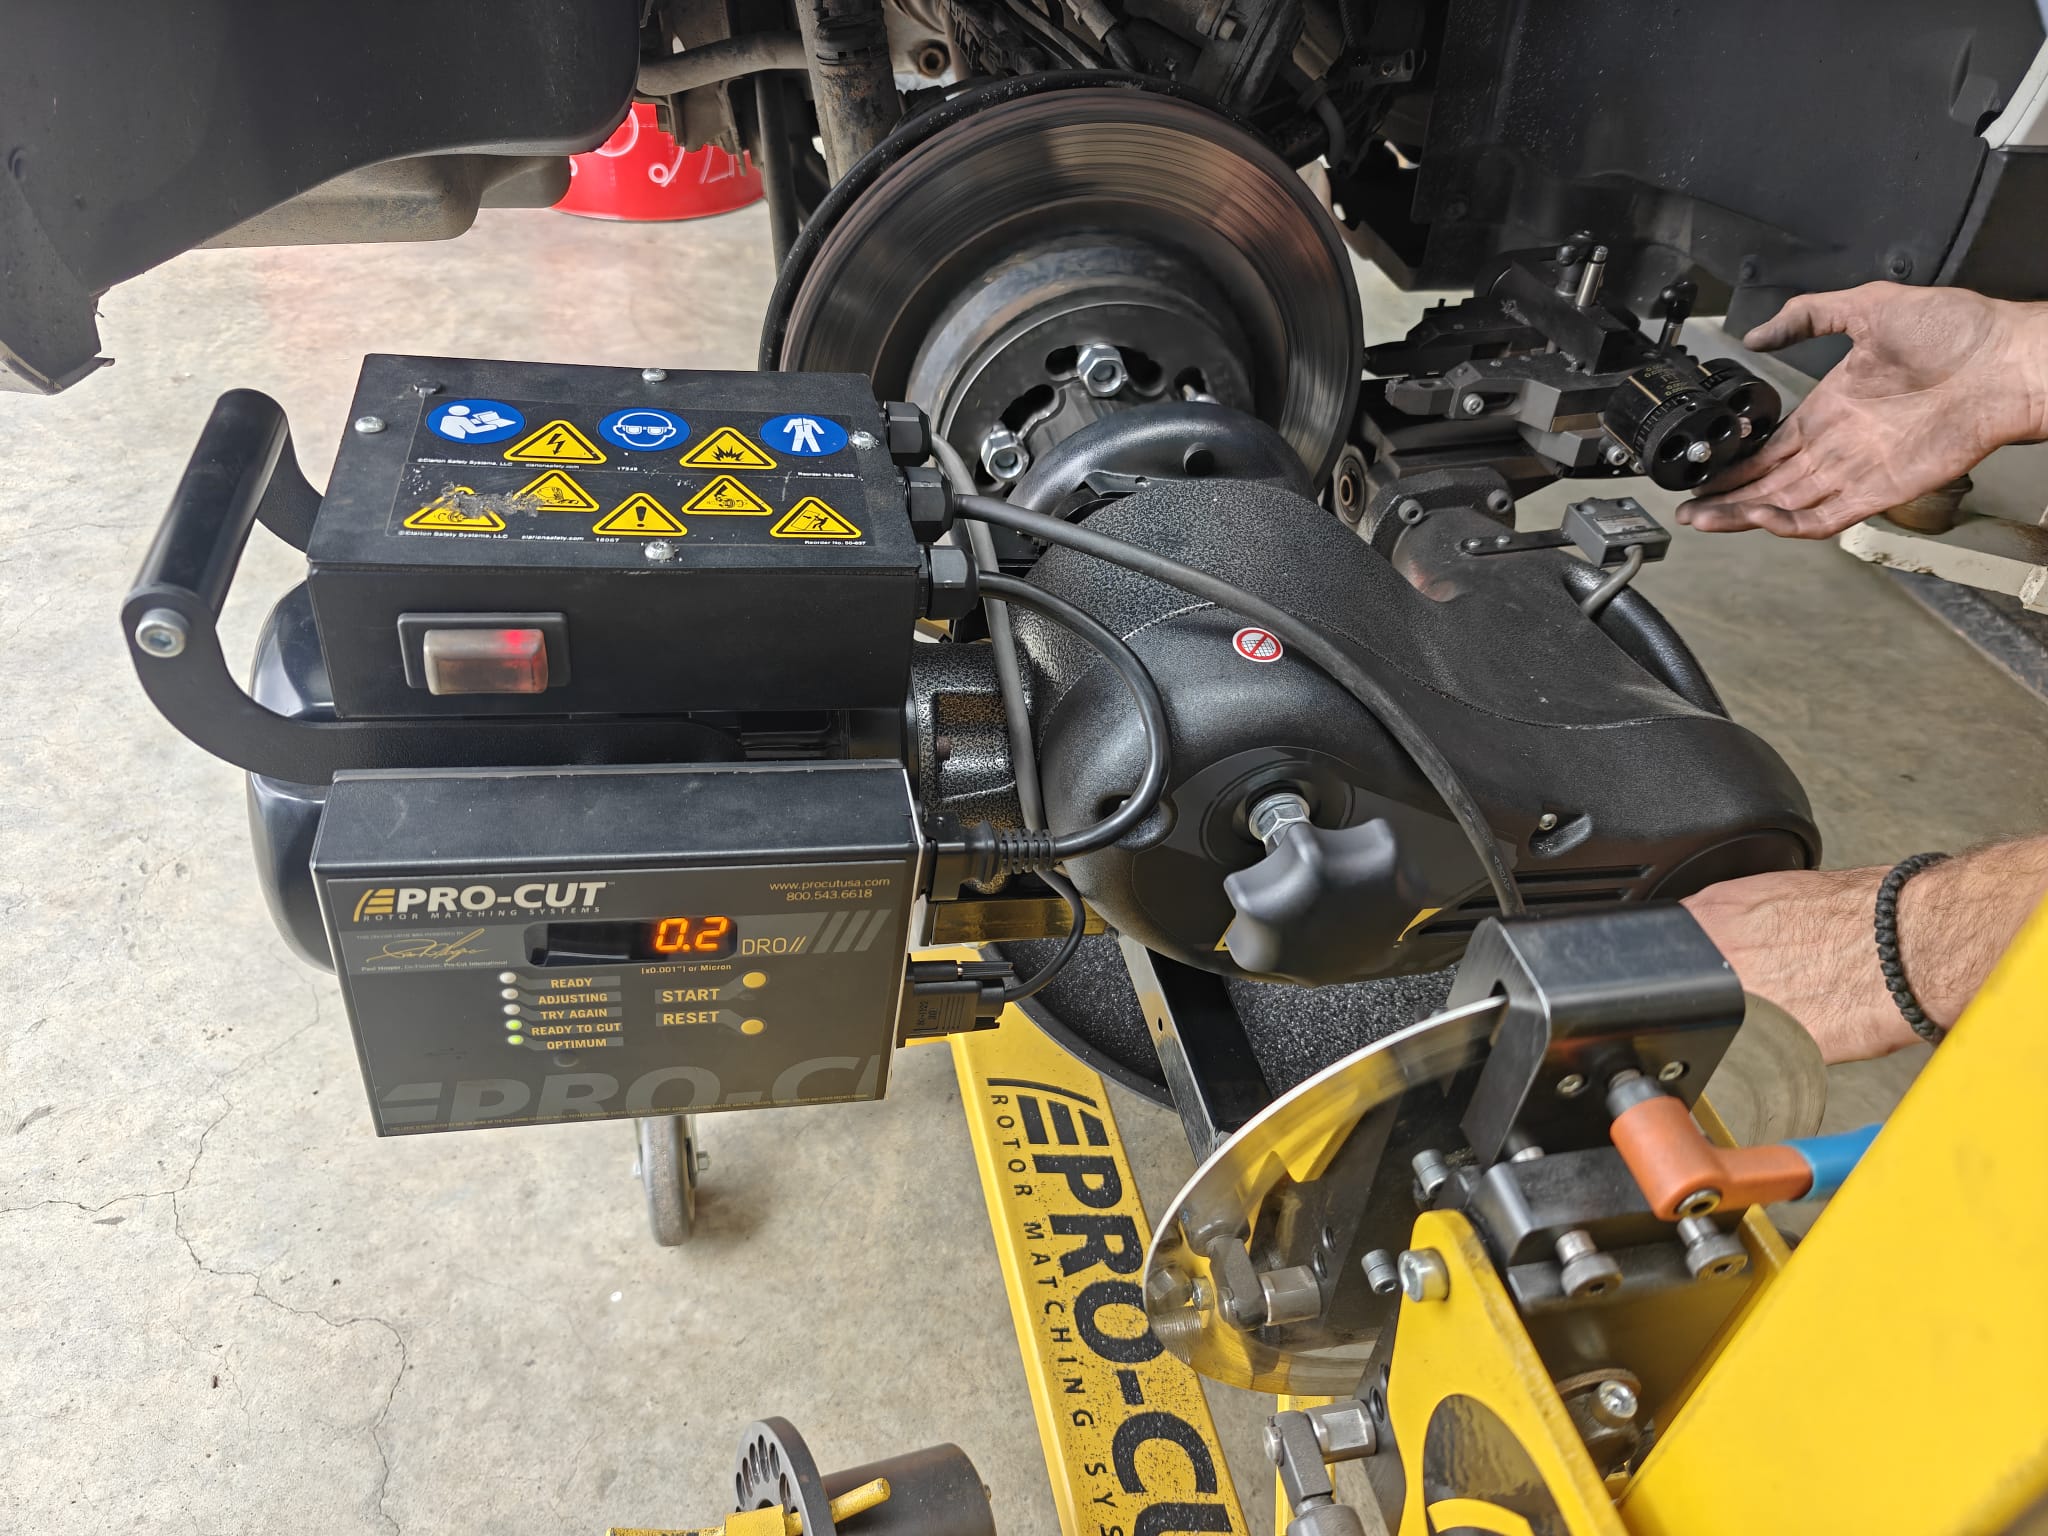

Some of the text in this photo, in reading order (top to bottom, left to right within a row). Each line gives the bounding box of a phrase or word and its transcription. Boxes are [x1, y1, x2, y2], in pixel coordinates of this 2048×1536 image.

[769, 878, 891, 891] www.procutusa.com
[397, 881, 607, 913] PRO-CUT
[786, 888, 874, 901] 800.543.6618
[363, 906, 601, 923] ROTOR MATCHING SYSTEMS
[654, 916, 728, 952] 0.2
[700, 963, 732, 972] Micron
[550, 977, 593, 989] READY
[538, 992, 608, 1006] ADJUSTING
[662, 988, 720, 1003] START
[540, 1008, 608, 1021] TRY AGAIN
[663, 1011, 719, 1026] RESET
[531, 1022, 622, 1037] READY TO CUT
[546, 1038, 608, 1050] OPTIMUM
[991, 1094, 1033, 1196] ROTOR
[1023, 1221, 1095, 1428] MATCHING
